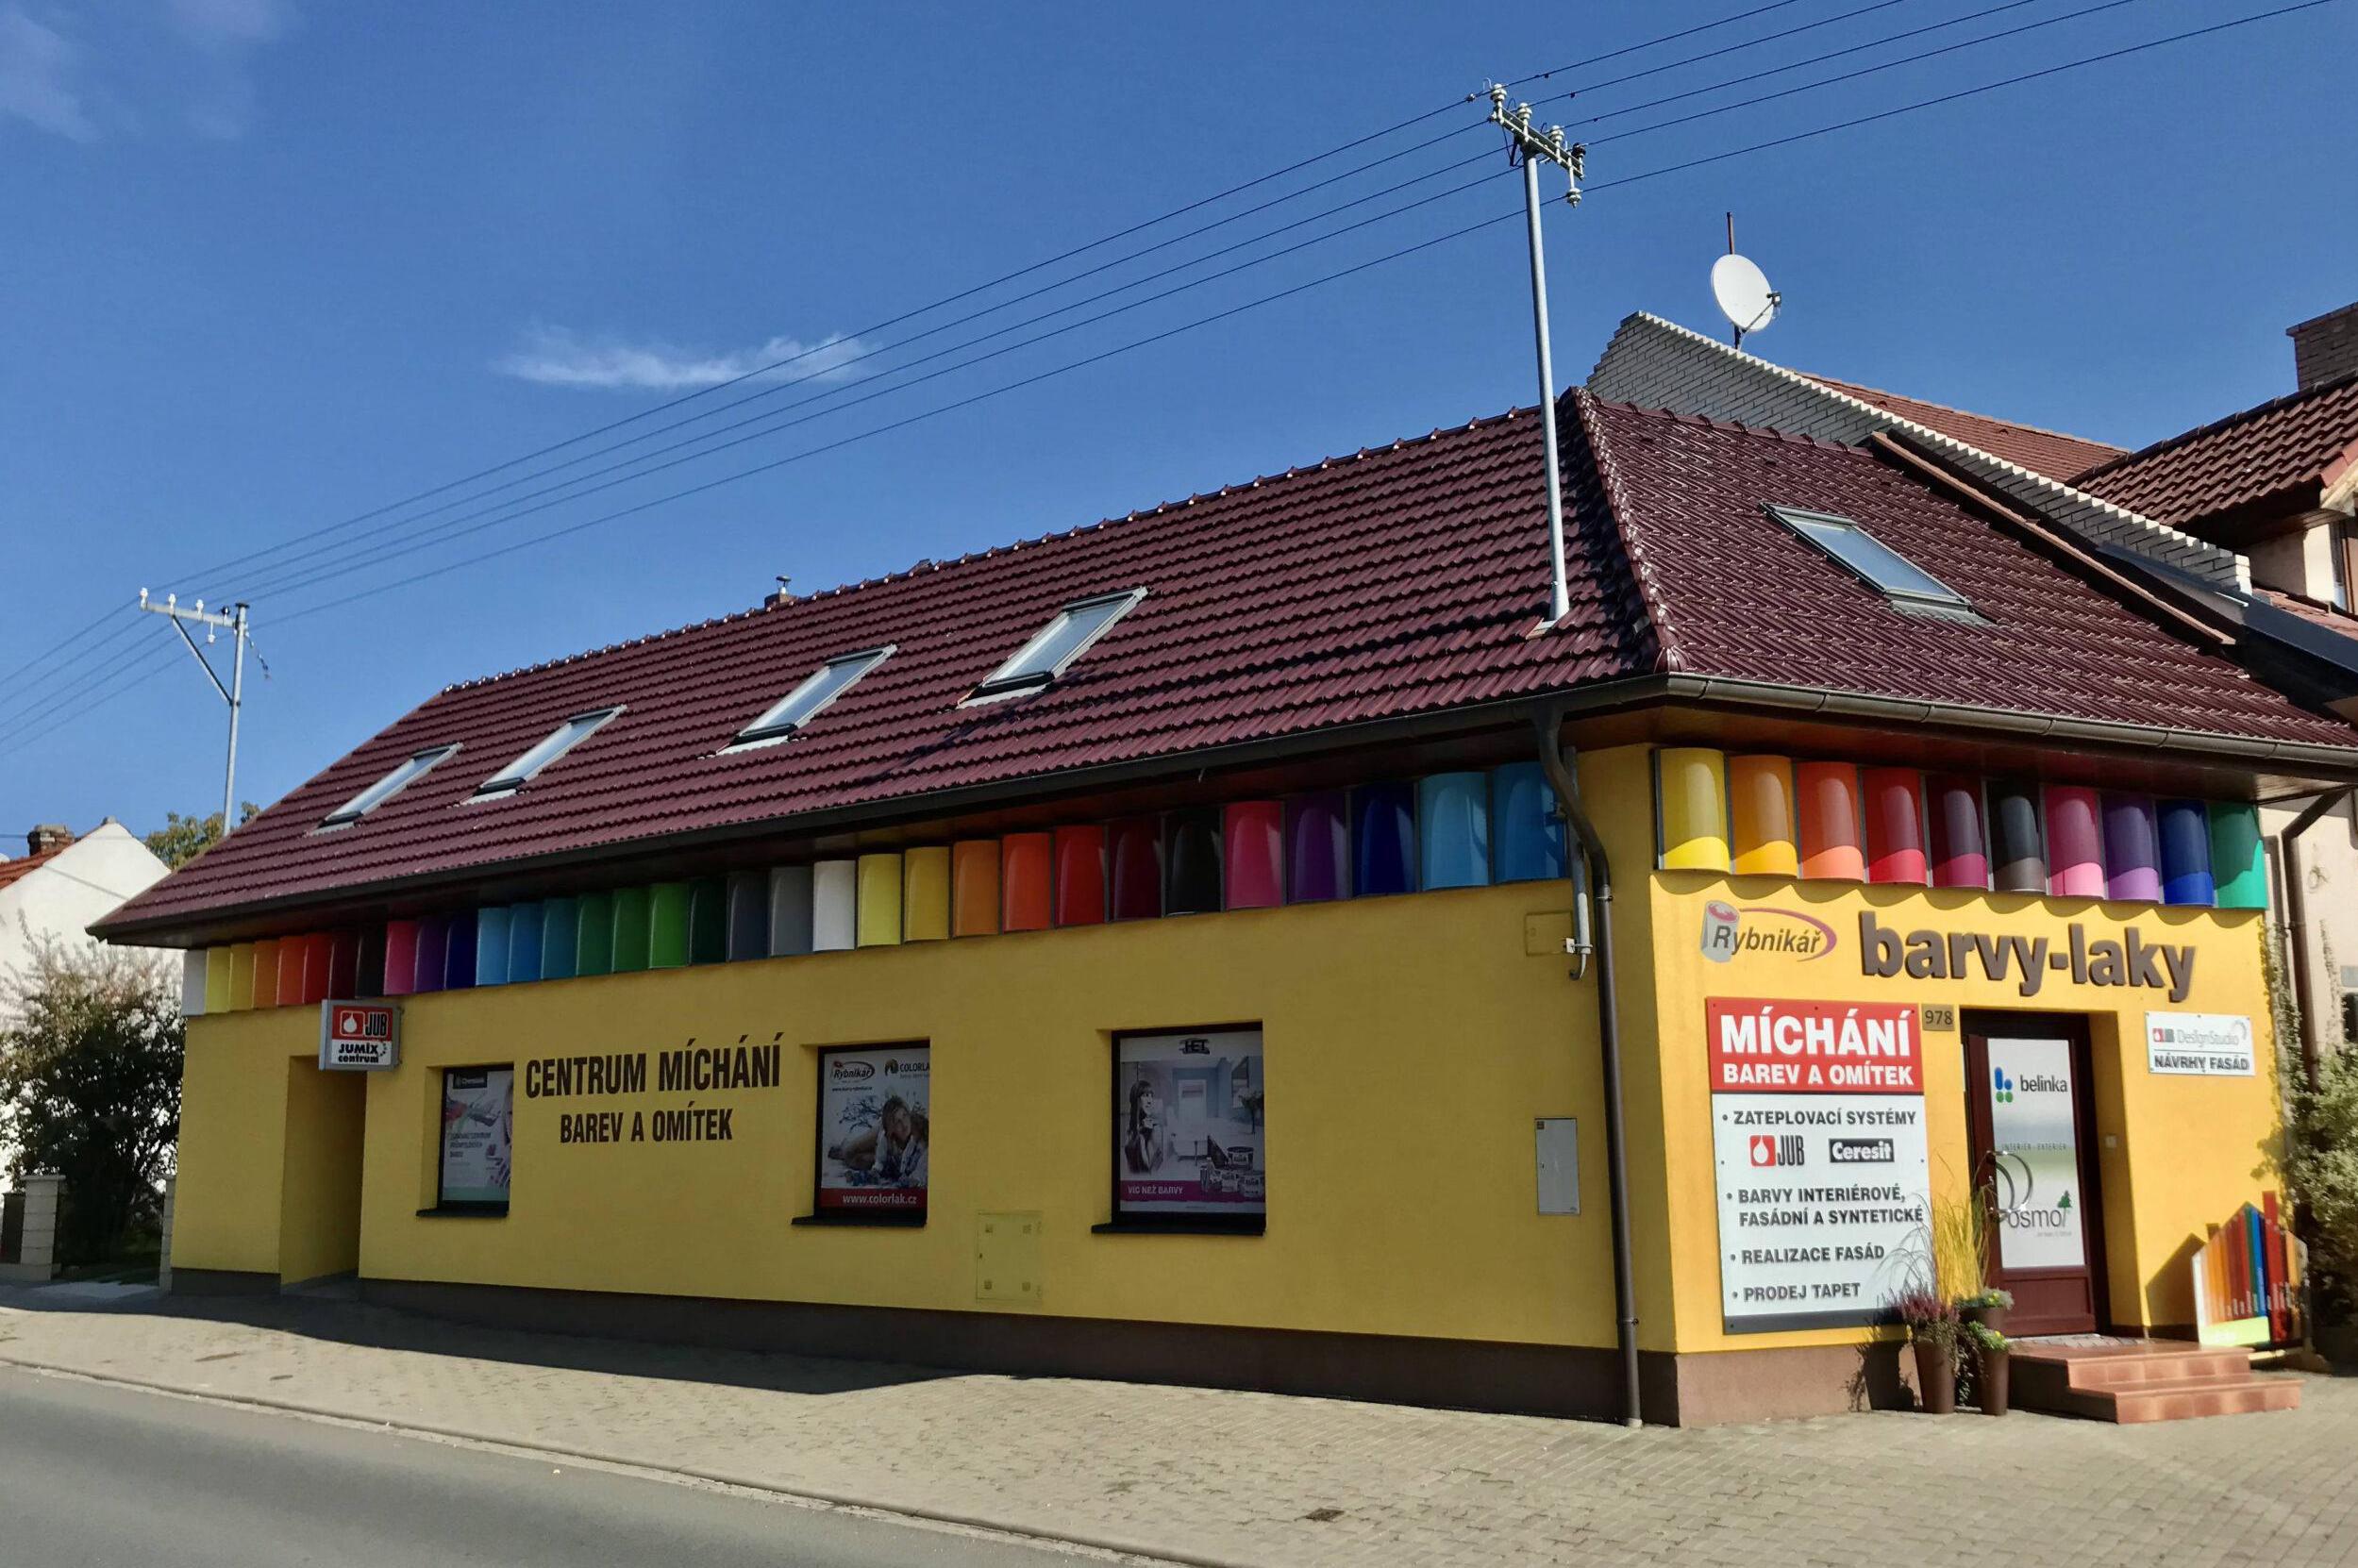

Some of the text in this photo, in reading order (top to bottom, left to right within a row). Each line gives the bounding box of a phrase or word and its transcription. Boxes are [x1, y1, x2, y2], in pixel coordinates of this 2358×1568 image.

[1713, 925, 1820, 955] Rybnikář
[1859, 910, 2197, 1003] barvy-laky
[364, 1011, 388, 1037] JUB
[1925, 1009, 1952, 1026] 978
[1720, 1006, 1911, 1057] MÍCHÁNÍ
[339, 1054, 378, 1062] centrum
[526, 1032, 784, 1098] CENTRUM MÍCHÁNÍ
[2154, 1053, 2249, 1070] NÁVRHY FASÁD
[1723, 1060, 1914, 1085] BAREV A OMÍTEK
[2020, 1075, 2068, 1093] belinka
[560, 1101, 733, 1143] BAREV A OMÍTEK
[1733, 1108, 1916, 1126] ZATEPLOVACÍ SYSTÉMY
[1777, 1135, 1893, 1166] JUB Ceresit
[843, 1193, 917, 1205] www.colorlak.cz
[1738, 1183, 1905, 1204] BARVY INTERIÉROVÉ,
[1739, 1205, 1924, 1226] FASÁDNÍ A SYNTETICKÉ
[2008, 1209, 2063, 1228] osmo
[1742, 1243, 1885, 1264] REALIZACE FASÁD
[1744, 1282, 1861, 1302] PRODEJ TAPET
